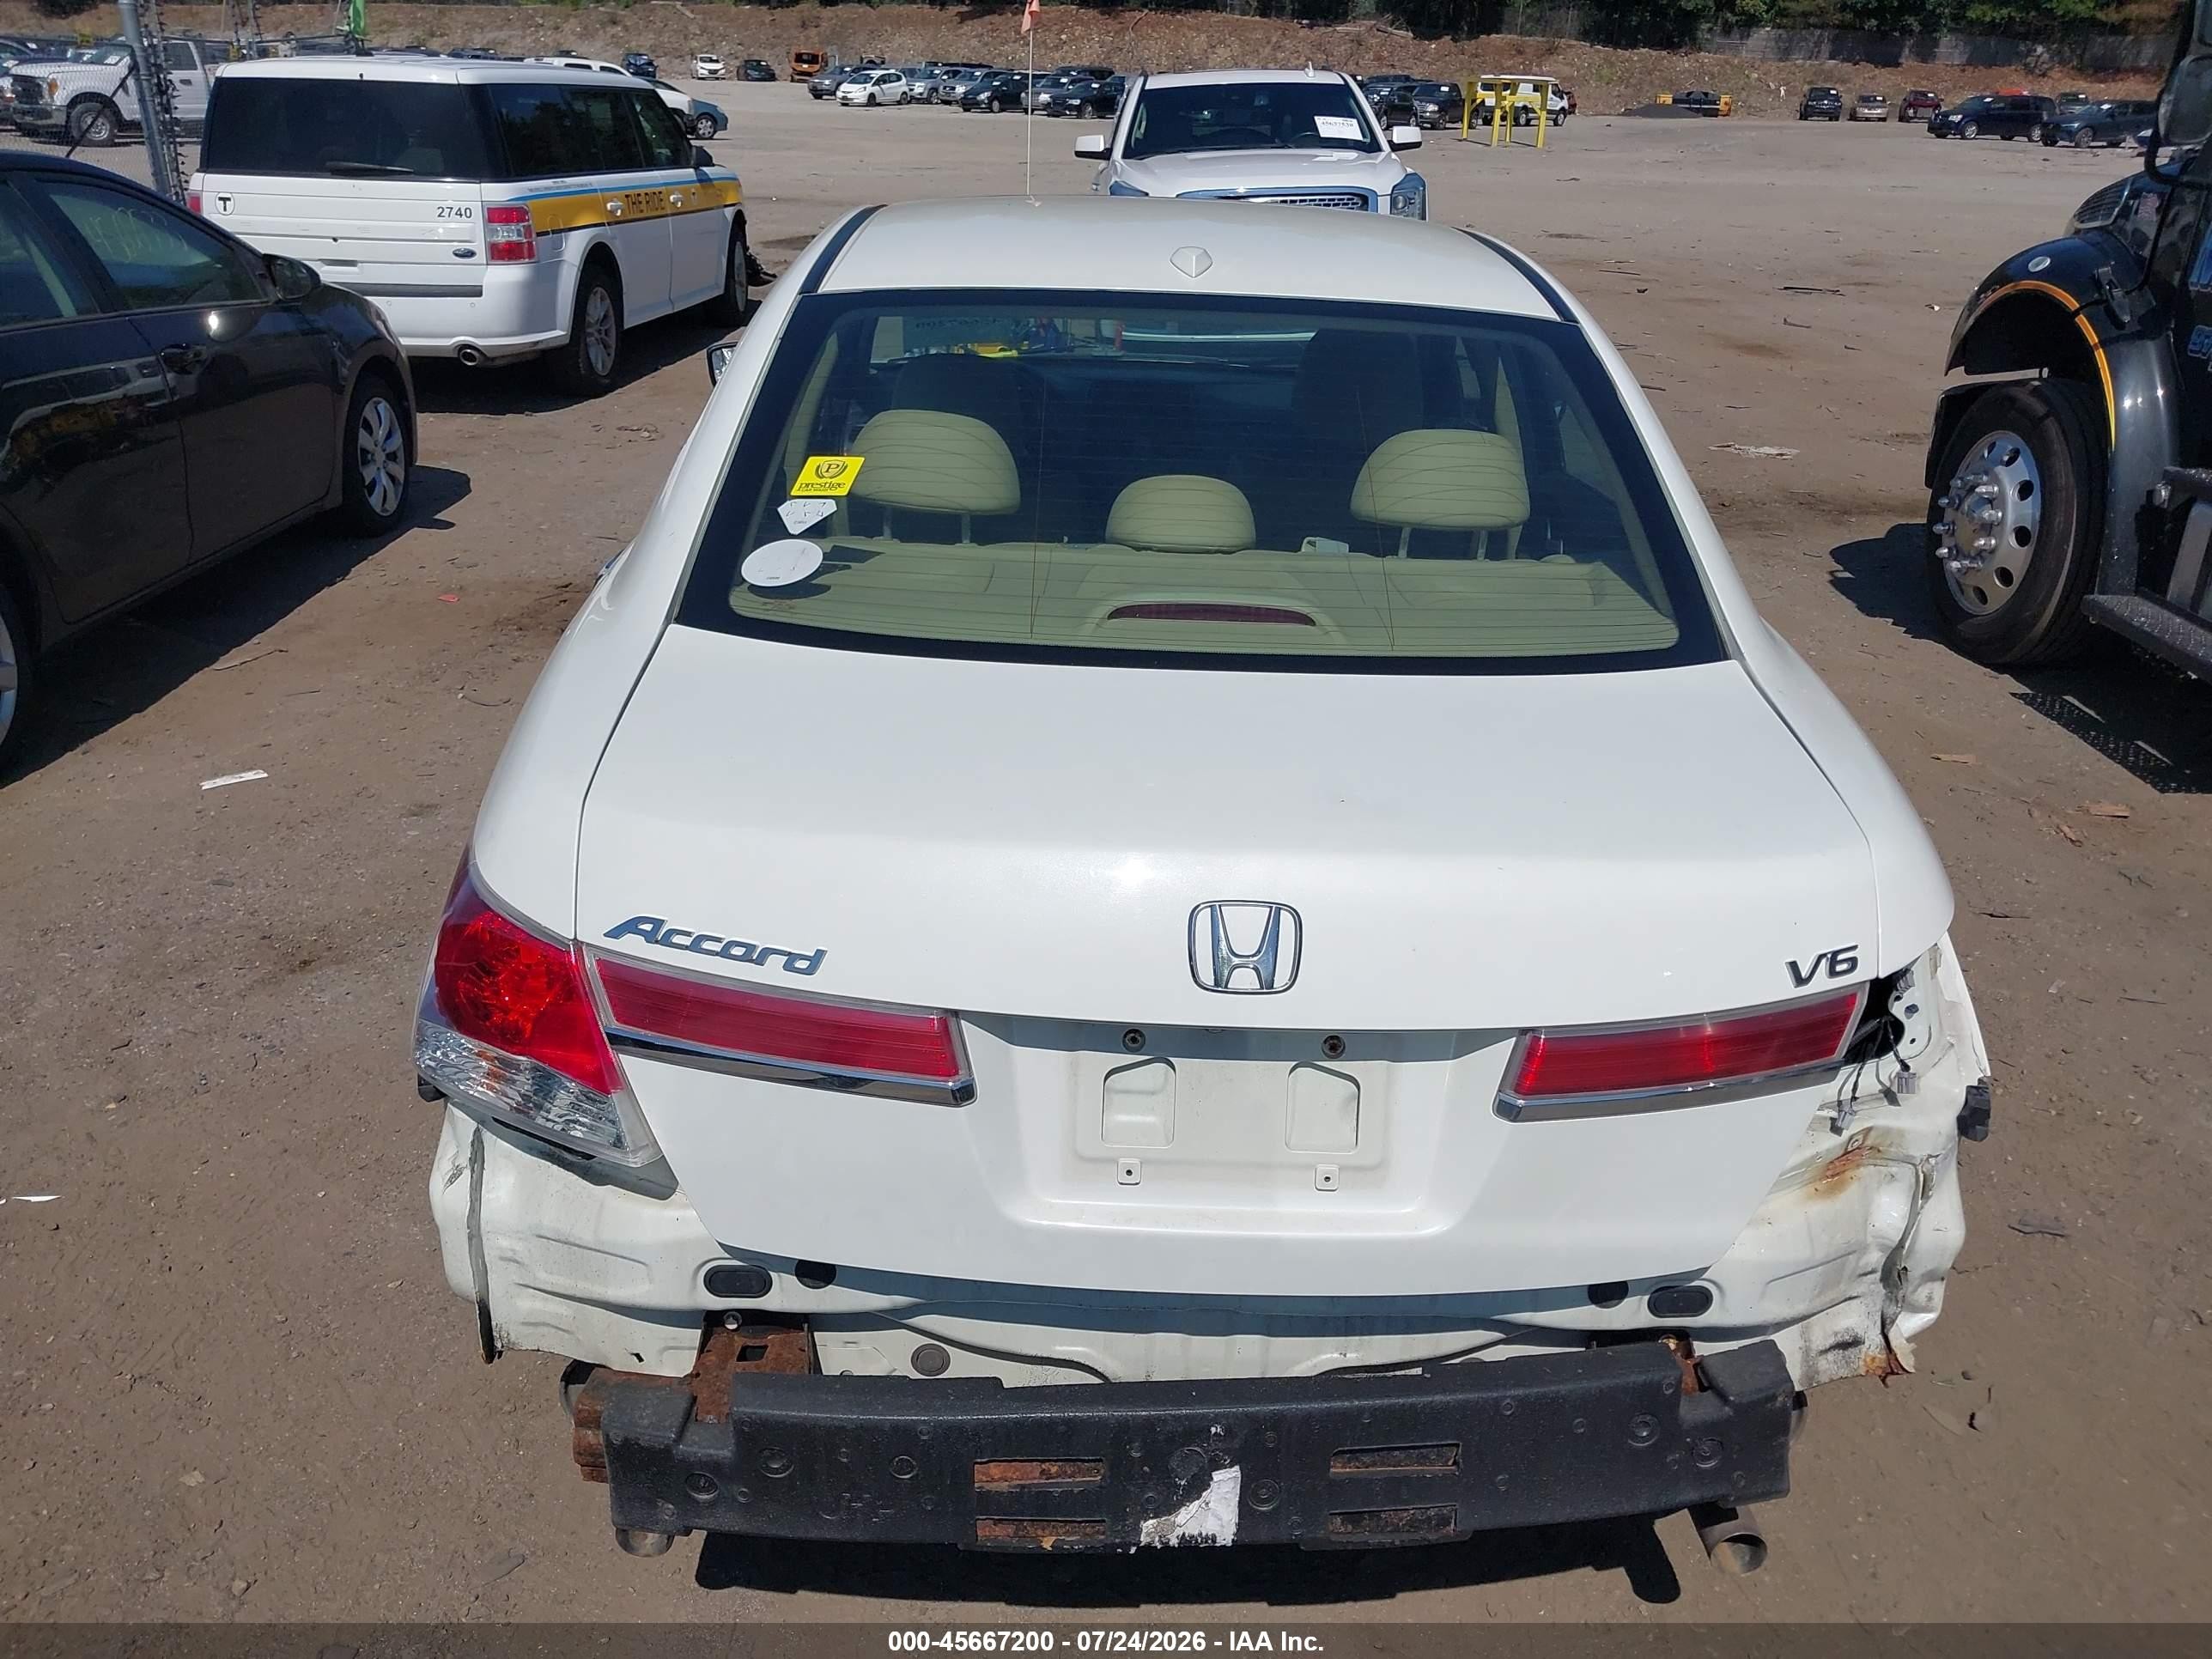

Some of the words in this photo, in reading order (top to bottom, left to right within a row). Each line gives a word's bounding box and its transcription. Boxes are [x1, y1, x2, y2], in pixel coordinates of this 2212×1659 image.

[217, 197, 232, 212] T
[624, 193, 644, 215] THE
[645, 191, 666, 211] RIDE
[436, 206, 472, 219] 2740
[823, 463, 840, 473] P
[797, 481, 847, 491] prestige
[603, 915, 828, 976] Accord
[1785, 945, 1859, 988] V6
